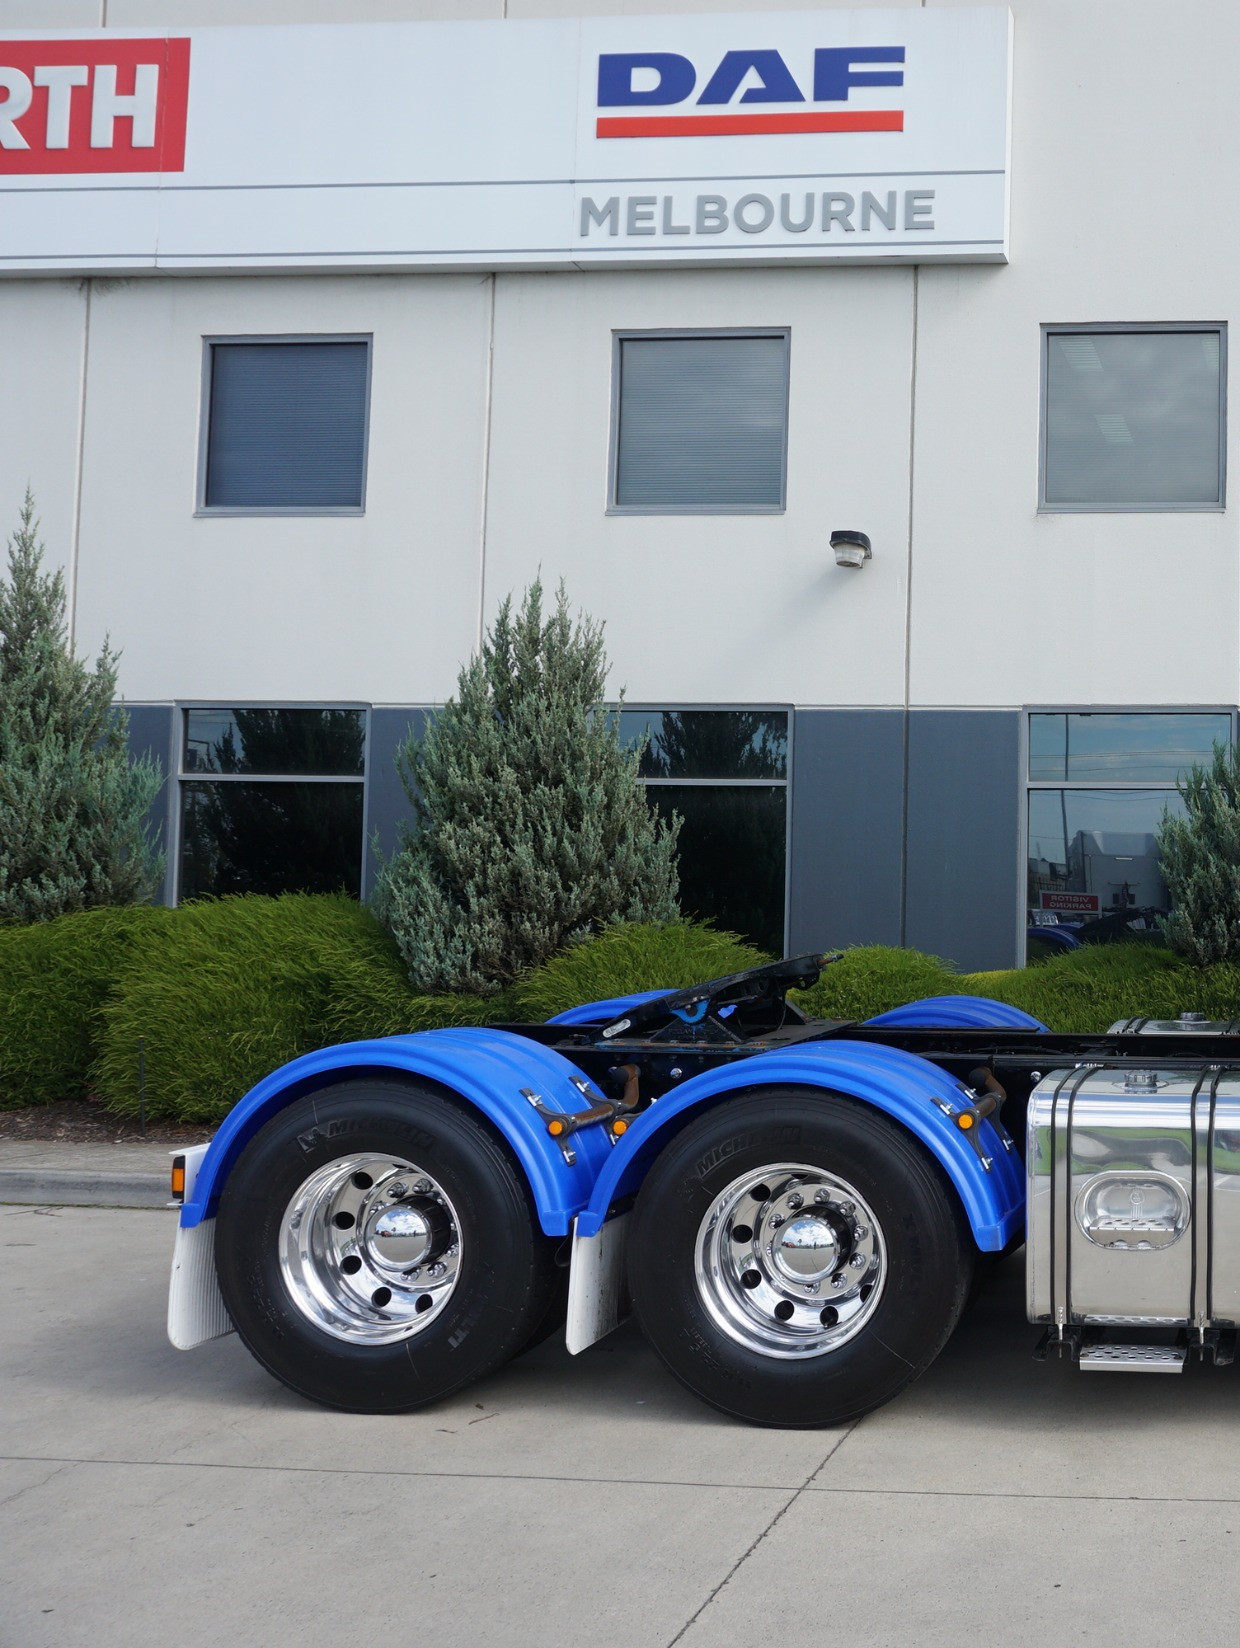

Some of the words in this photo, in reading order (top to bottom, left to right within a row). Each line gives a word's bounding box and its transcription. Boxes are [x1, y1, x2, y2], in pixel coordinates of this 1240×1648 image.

[0, 64, 159, 150] RTH
[597, 46, 906, 107] DAF
[580, 189, 936, 237] MELBOURNE
